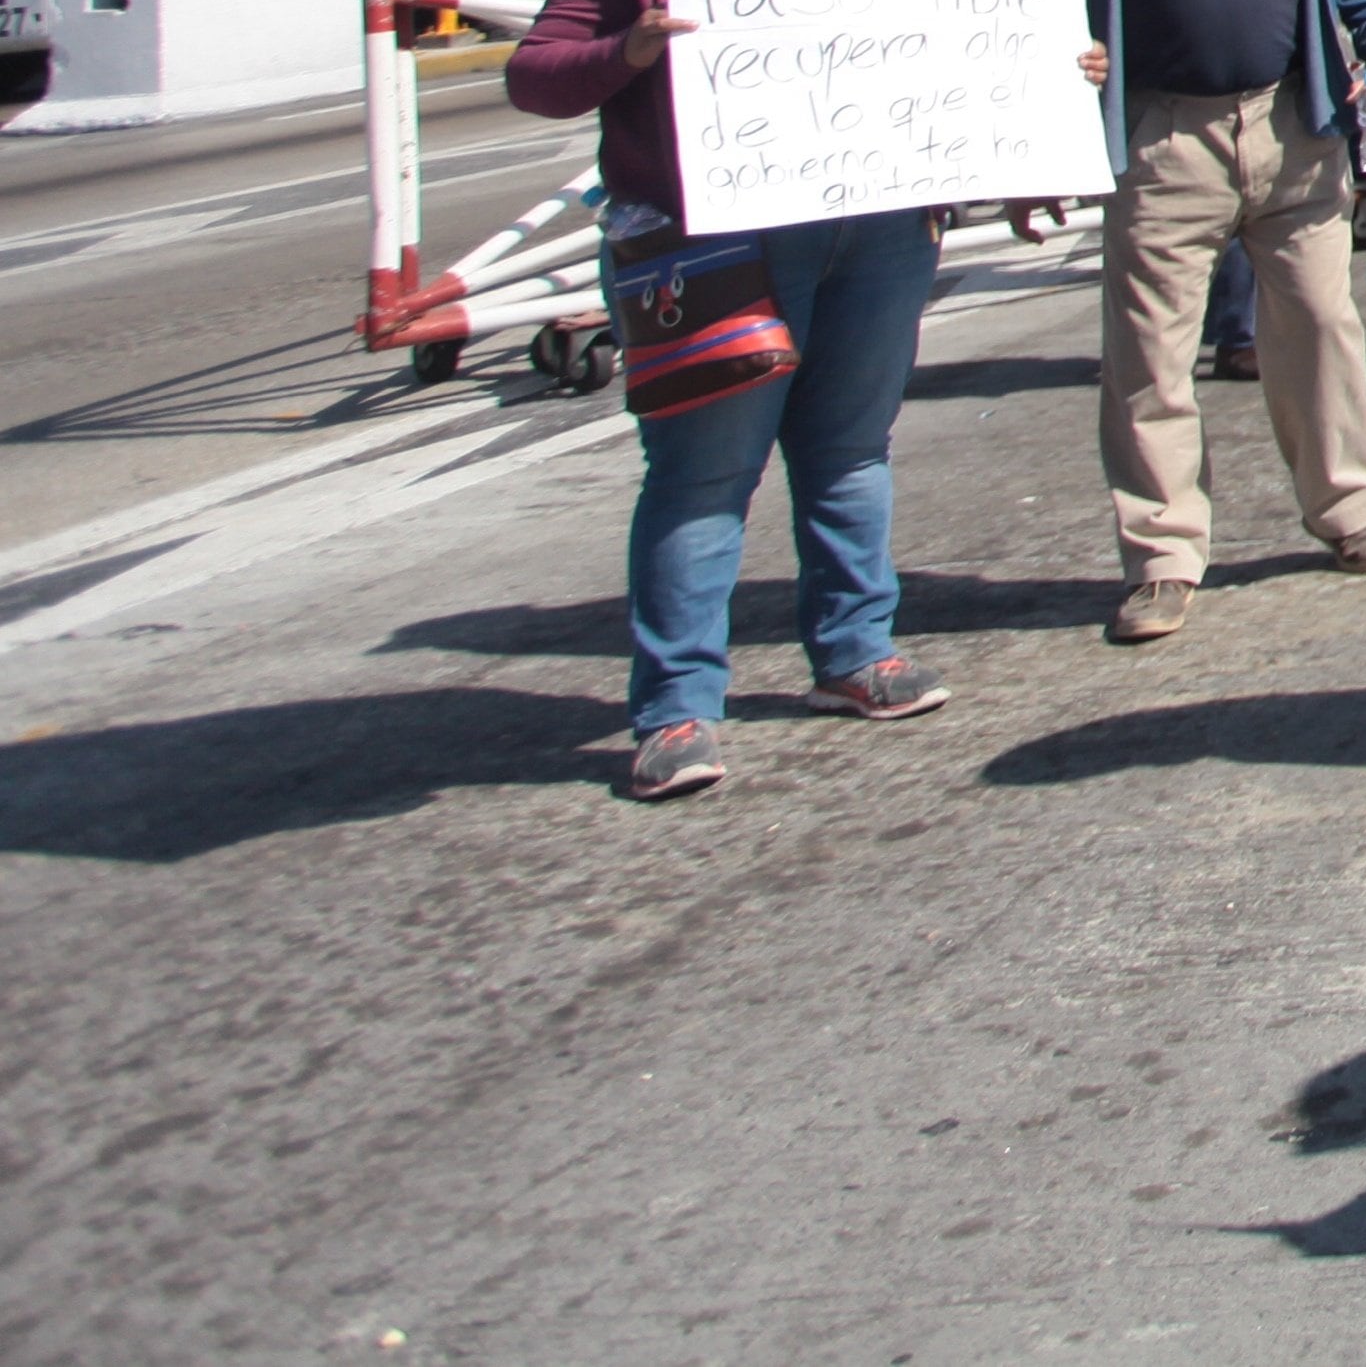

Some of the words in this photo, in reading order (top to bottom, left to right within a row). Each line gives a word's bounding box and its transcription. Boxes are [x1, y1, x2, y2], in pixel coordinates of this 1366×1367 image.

[699, 32, 928, 99] recupera
[964, 17, 1041, 82] algo
[701, 101, 777, 151] de
[808, 91, 863, 134] lo
[888, 86, 968, 140] que
[706, 147, 885, 209] gobierno
[915, 125, 970, 162] te
[822, 165, 981, 213] quitado
